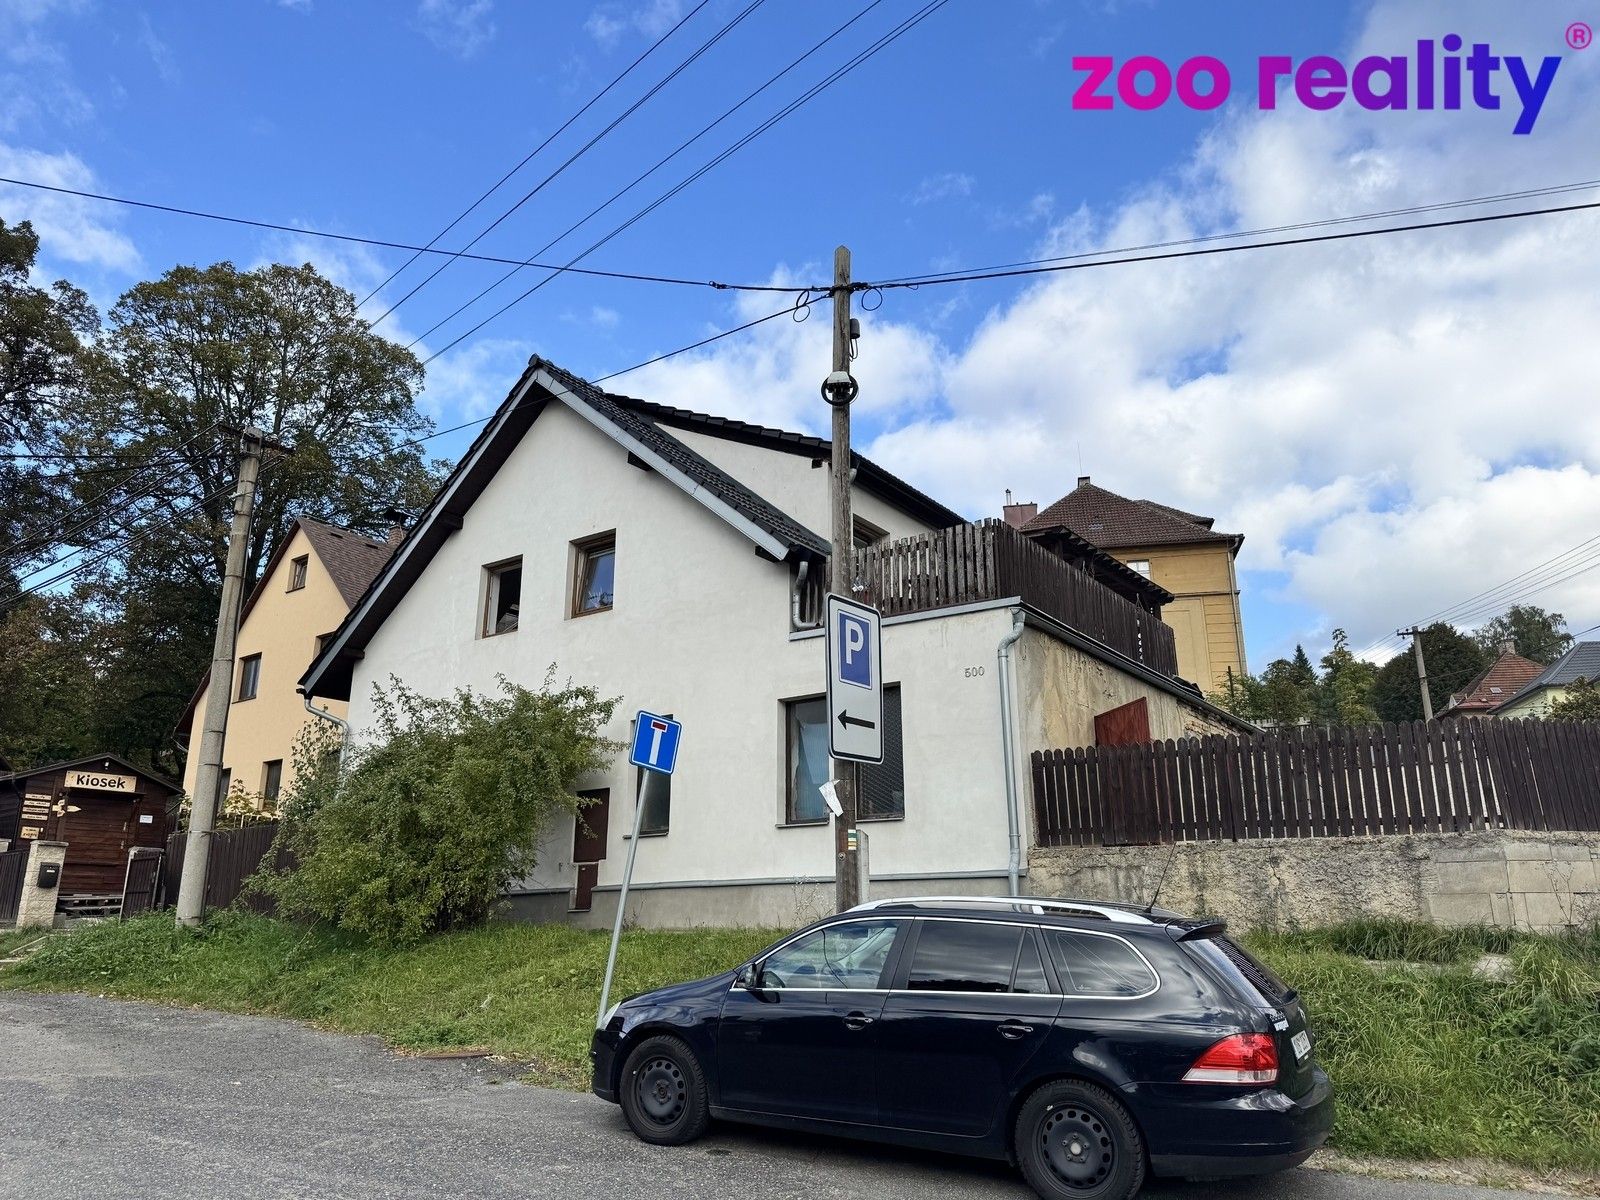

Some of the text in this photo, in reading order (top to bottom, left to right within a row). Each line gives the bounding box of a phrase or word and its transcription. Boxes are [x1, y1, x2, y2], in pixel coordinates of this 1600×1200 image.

[845, 619, 864, 665] P
[964, 666, 985, 678] 500
[76, 774, 126, 789] Kiosek
